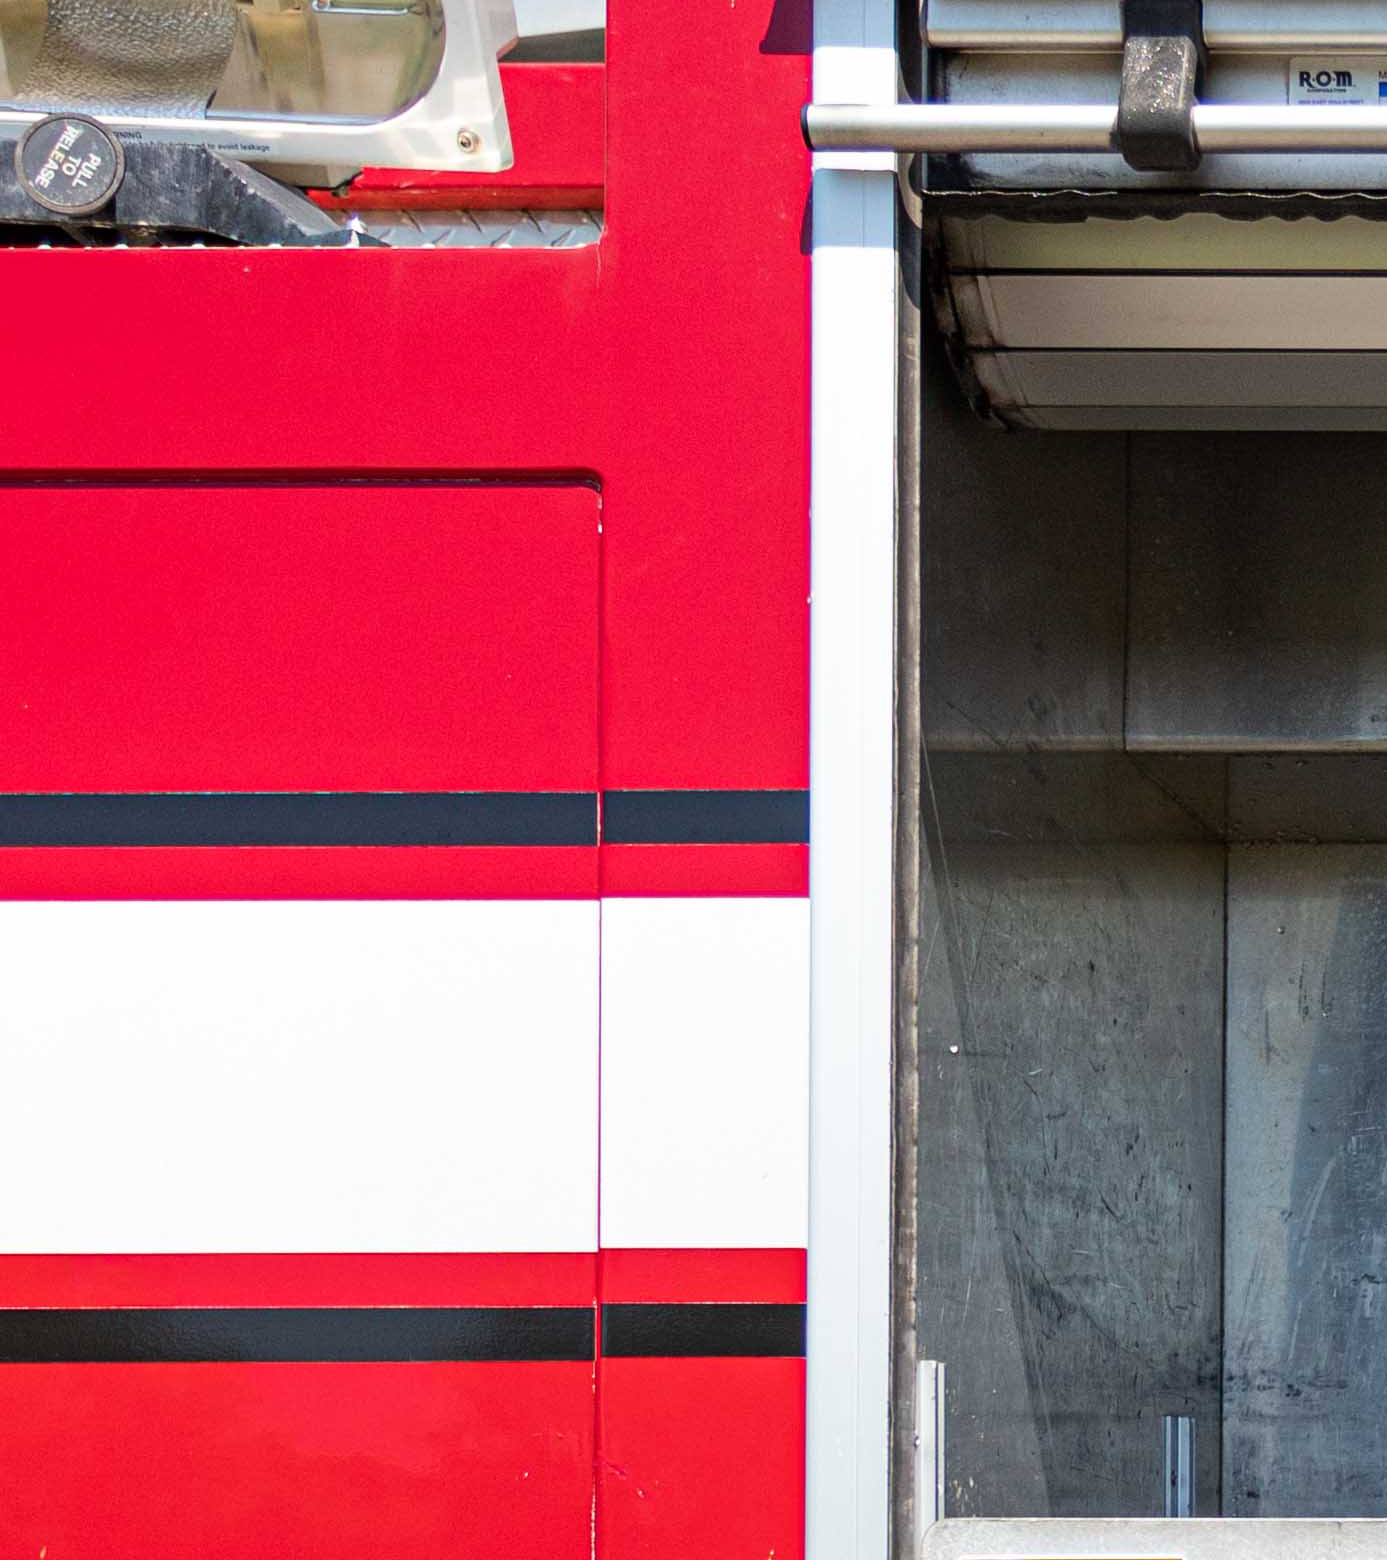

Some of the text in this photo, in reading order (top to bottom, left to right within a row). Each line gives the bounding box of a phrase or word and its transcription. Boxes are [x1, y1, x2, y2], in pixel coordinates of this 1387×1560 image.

[35, 125, 81, 189] RELEASE
[62, 155, 82, 177] TO
[71, 153, 102, 188] PULL
